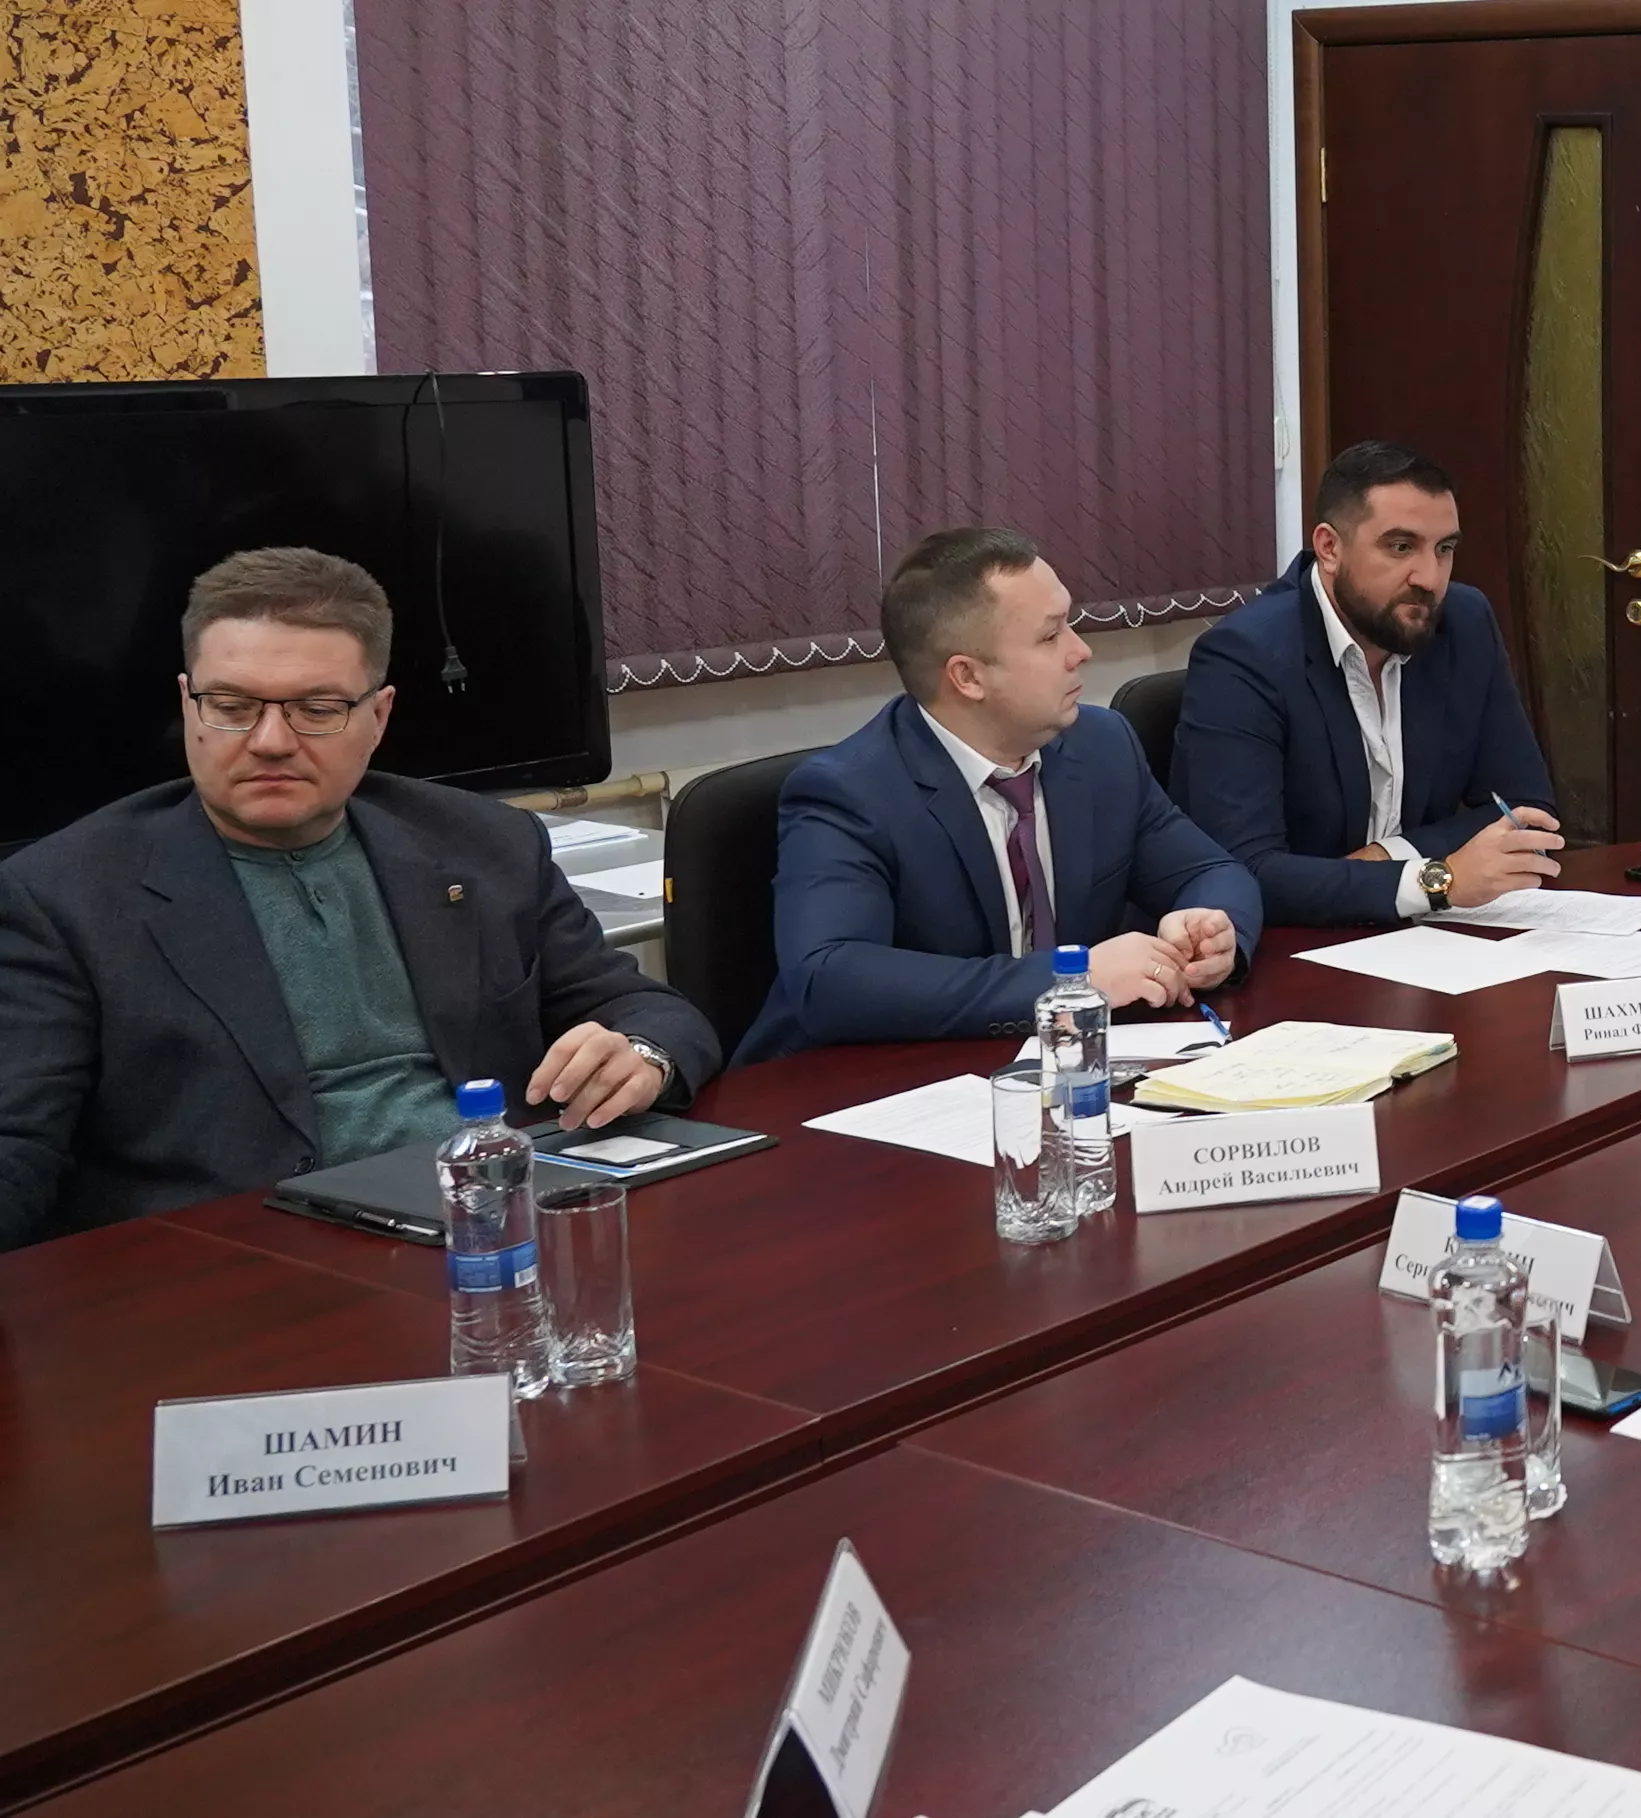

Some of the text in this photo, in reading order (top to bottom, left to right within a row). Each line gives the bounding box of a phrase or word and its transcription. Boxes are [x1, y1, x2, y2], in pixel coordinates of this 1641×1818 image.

[1584, 1027, 1629, 1041] Ринад
[1194, 1136, 1321, 1165] СОРВИЛОВ
[1158, 1161, 1360, 1196] Андрей Васильевич
[263, 1419, 404, 1456] ШАМИН
[207, 1456, 459, 1498] Иван Семенович
